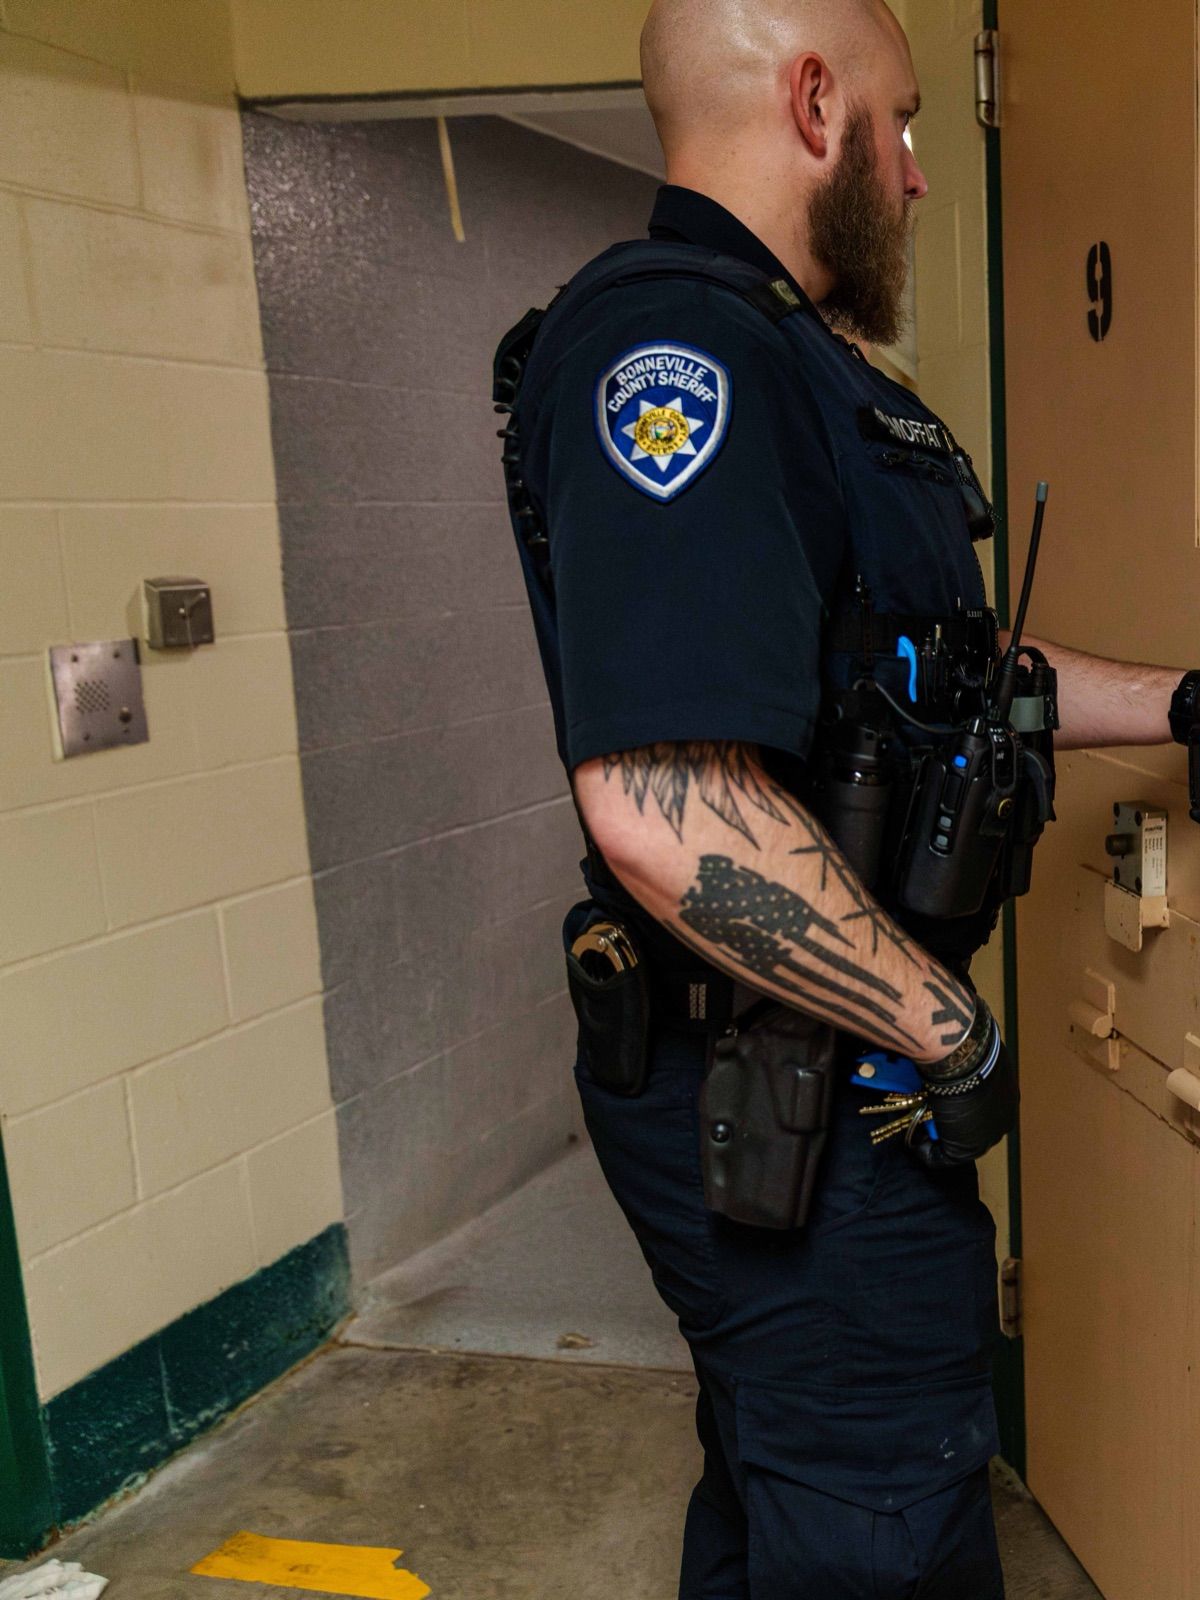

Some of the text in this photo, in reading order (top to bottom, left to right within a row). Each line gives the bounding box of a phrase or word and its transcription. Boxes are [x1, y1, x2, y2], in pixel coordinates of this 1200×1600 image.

[1086, 241, 1112, 342] 9
[615, 355, 708, 386] BONNEVILLE
[607, 370, 718, 413] COUNTY SHERIFF
[886, 415, 942, 448] MOFFAT
